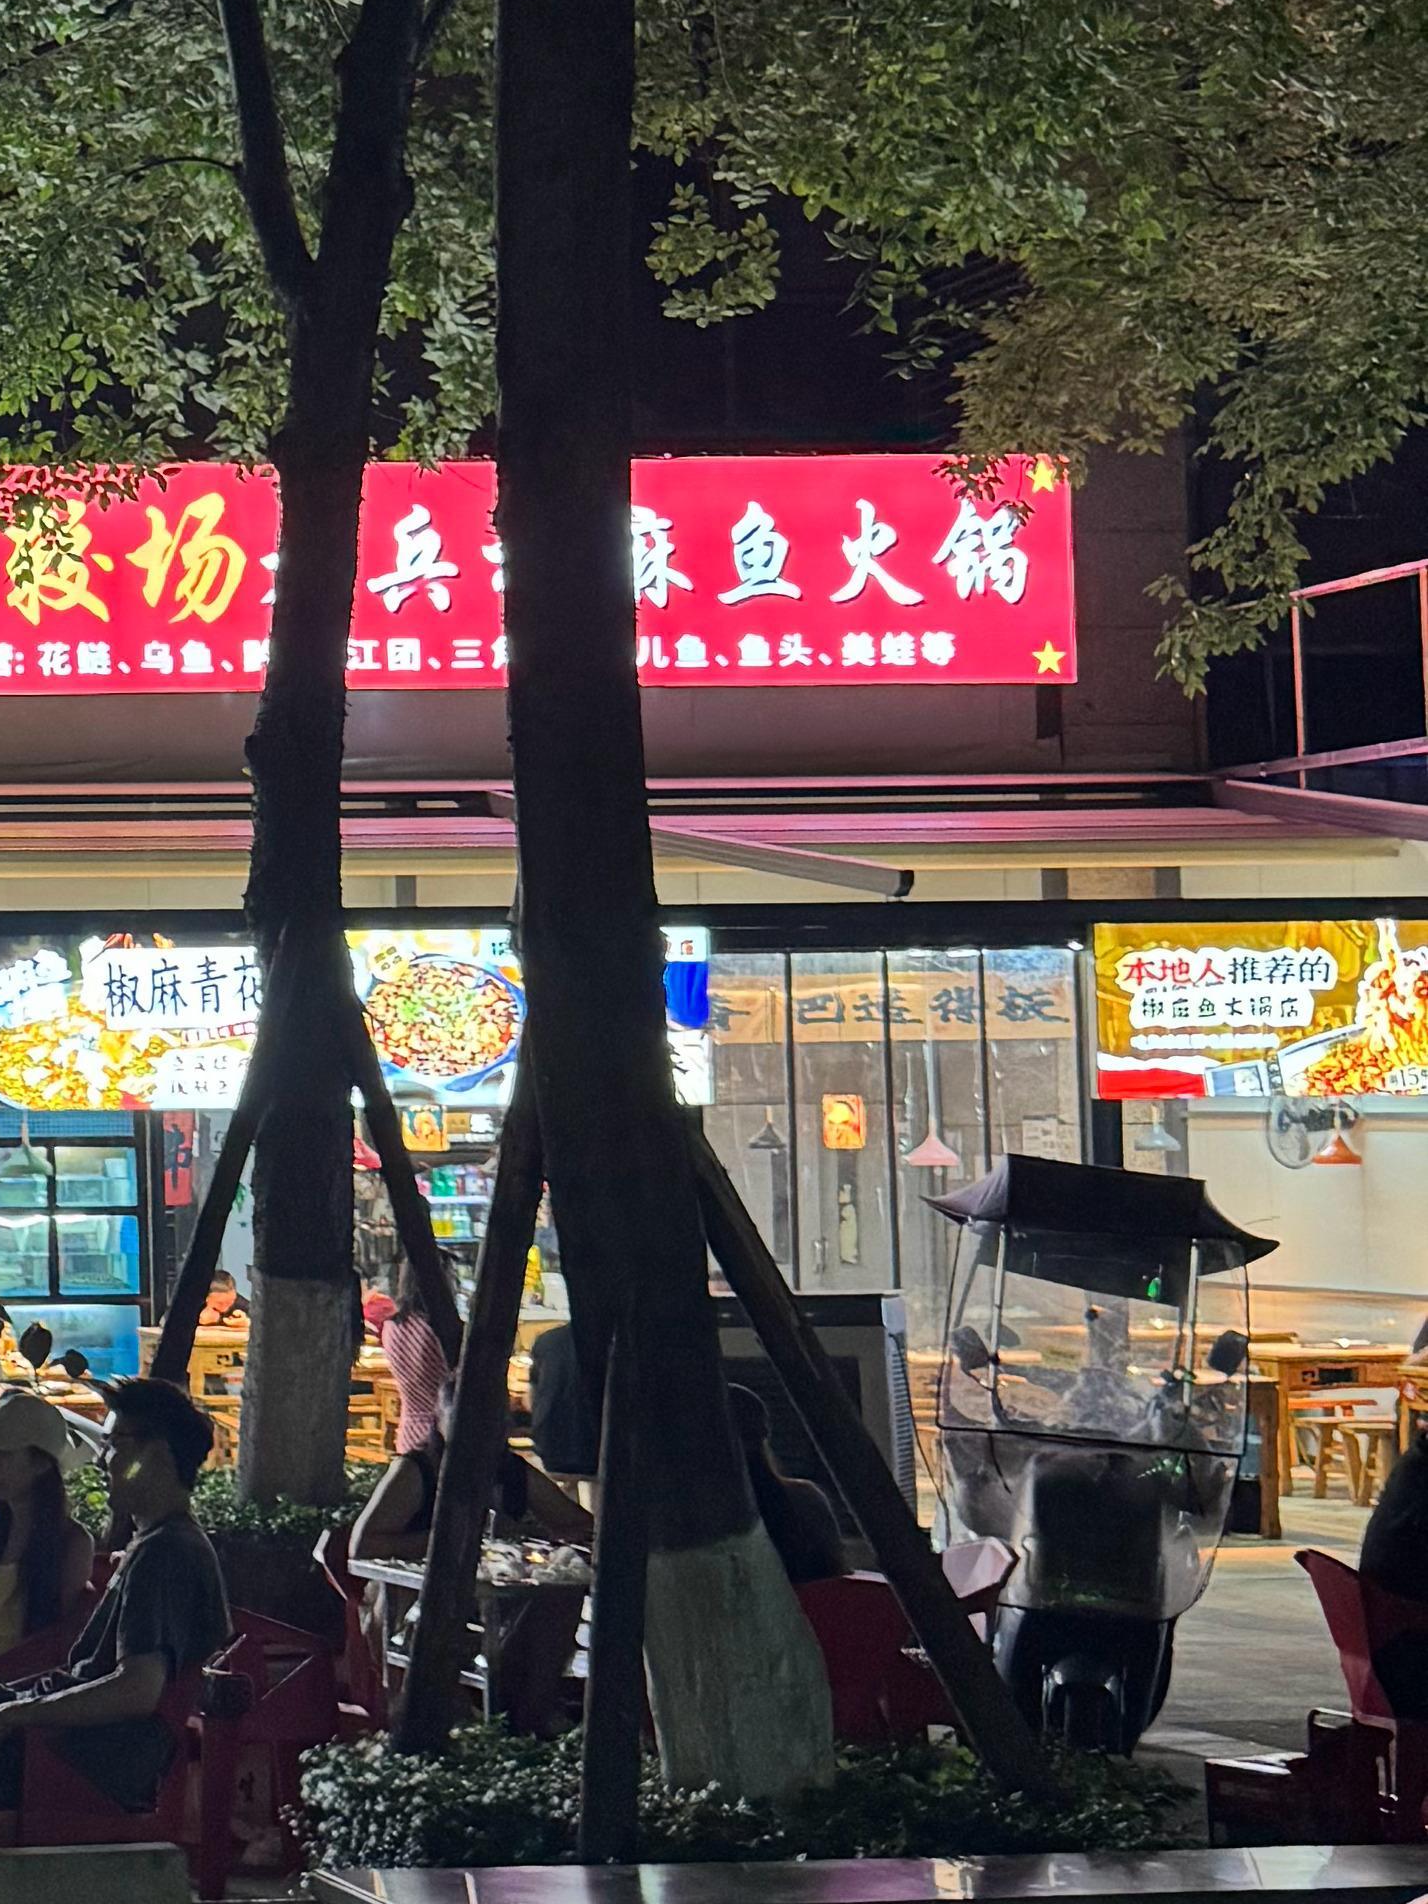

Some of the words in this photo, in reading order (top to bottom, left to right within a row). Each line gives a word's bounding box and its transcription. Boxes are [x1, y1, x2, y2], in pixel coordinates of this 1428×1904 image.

[1123, 954, 1331, 986] 本地人推荐的
